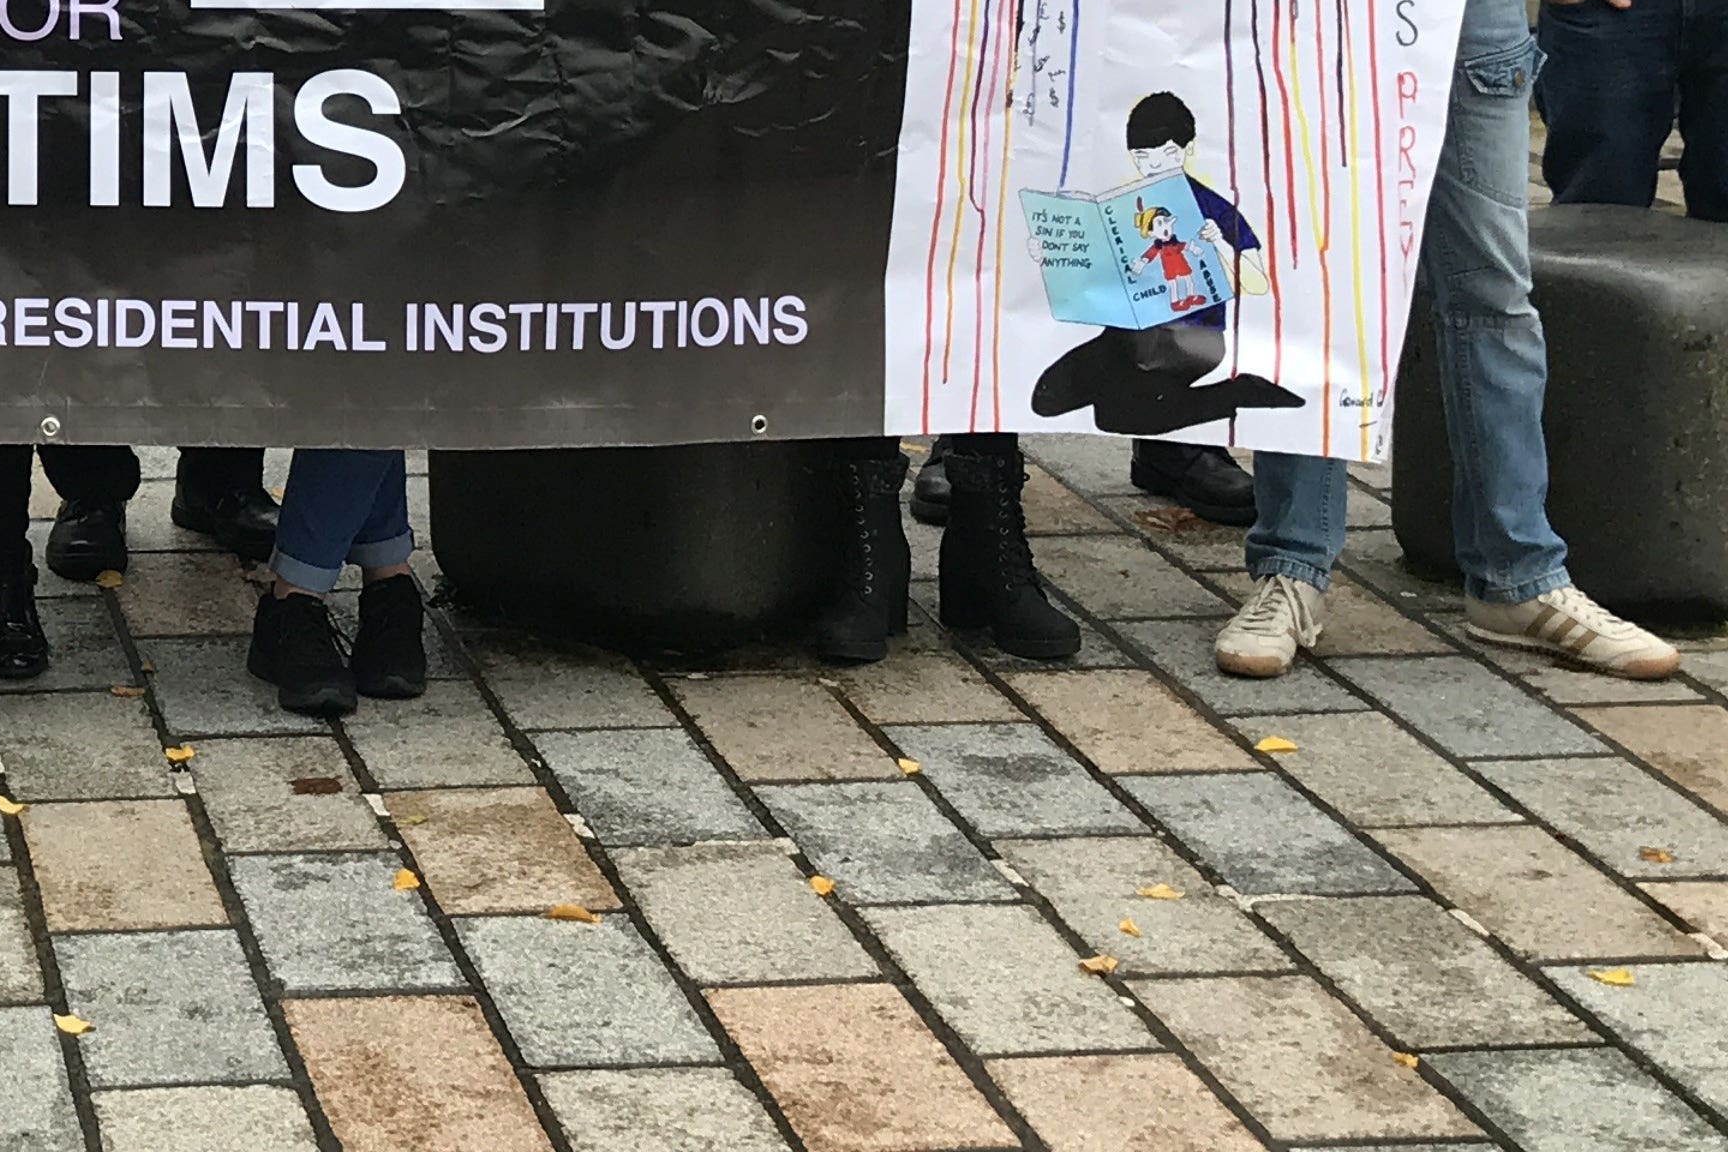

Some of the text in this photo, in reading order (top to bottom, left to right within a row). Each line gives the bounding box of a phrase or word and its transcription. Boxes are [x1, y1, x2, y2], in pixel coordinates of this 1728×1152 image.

[1051, 214, 1073, 225] NOT
[1074, 216, 1082, 227] A
[1035, 225, 1085, 240] SIN IF YOU
[1072, 242, 1090, 254] SAY
[1105, 205, 1137, 285] CLERICAL
[1040, 256, 1093, 270] ANYTHING
[1133, 284, 1168, 302] CHILD
[405, 294, 809, 354] INSTITUTIONS
